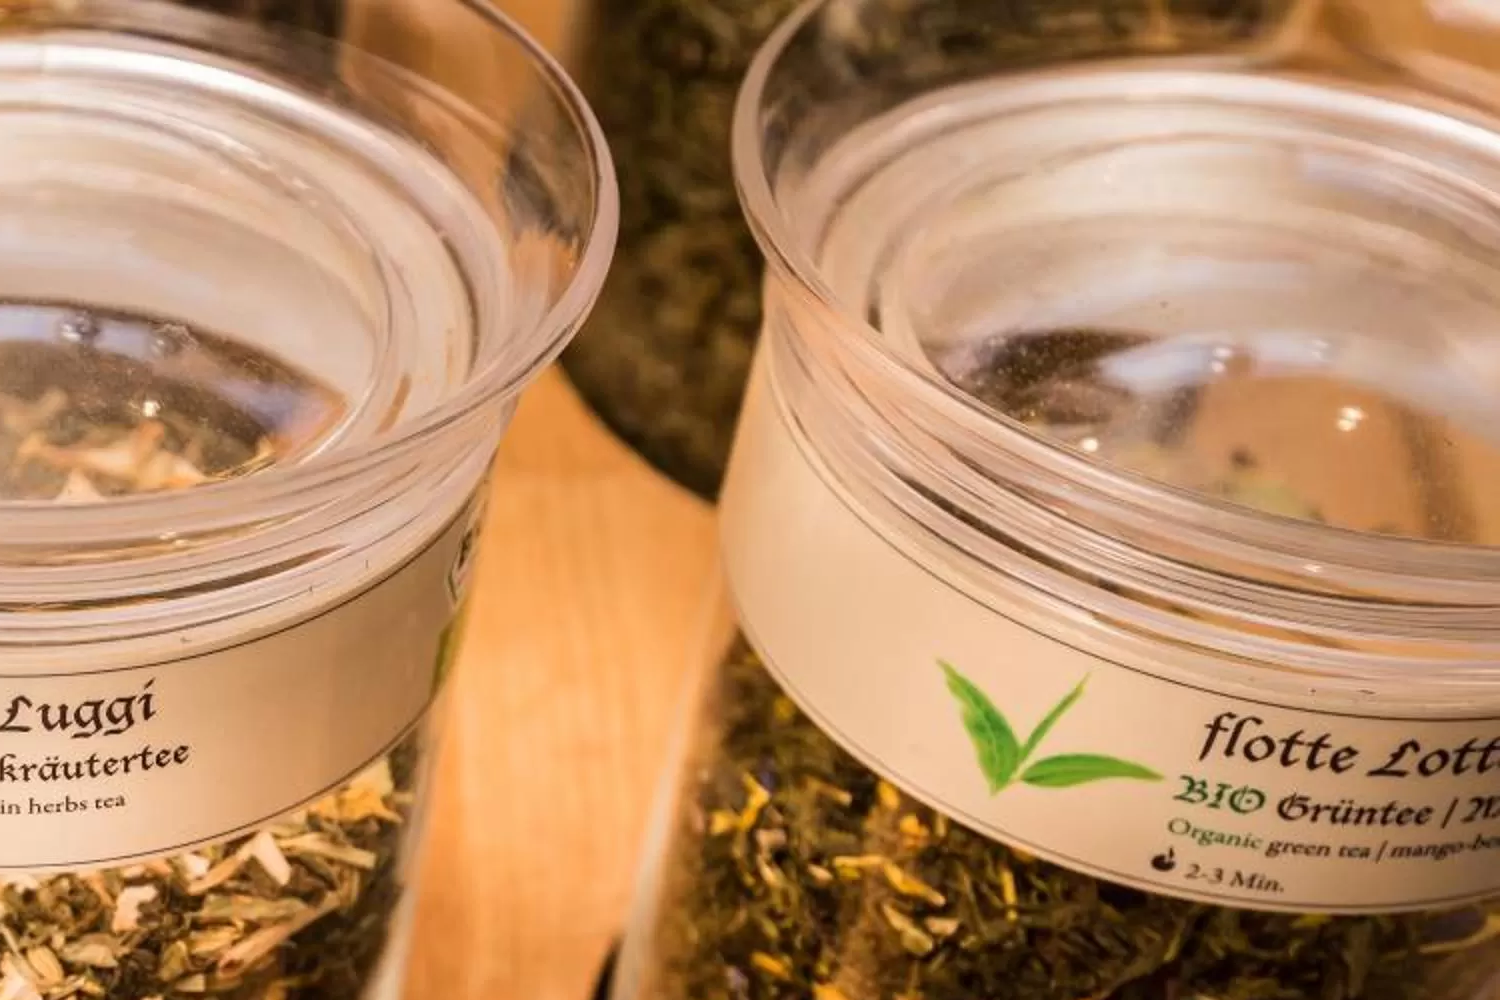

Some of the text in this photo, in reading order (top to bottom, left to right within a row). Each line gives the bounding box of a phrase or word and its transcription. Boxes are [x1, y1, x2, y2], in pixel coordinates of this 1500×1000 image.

[1198, 711, 1500, 778] flotte Lott
[28, 795, 88, 816] herbs
[95, 794, 127, 810] tea
[1172, 774, 1266, 814] BIO
[1277, 791, 1435, 827] Grüntee
[1167, 817, 1263, 849] Organic
[1265, 840, 1331, 859] green
[1338, 844, 1371, 859] tea
[1184, 863, 1285, 893] 2-3 Min.
